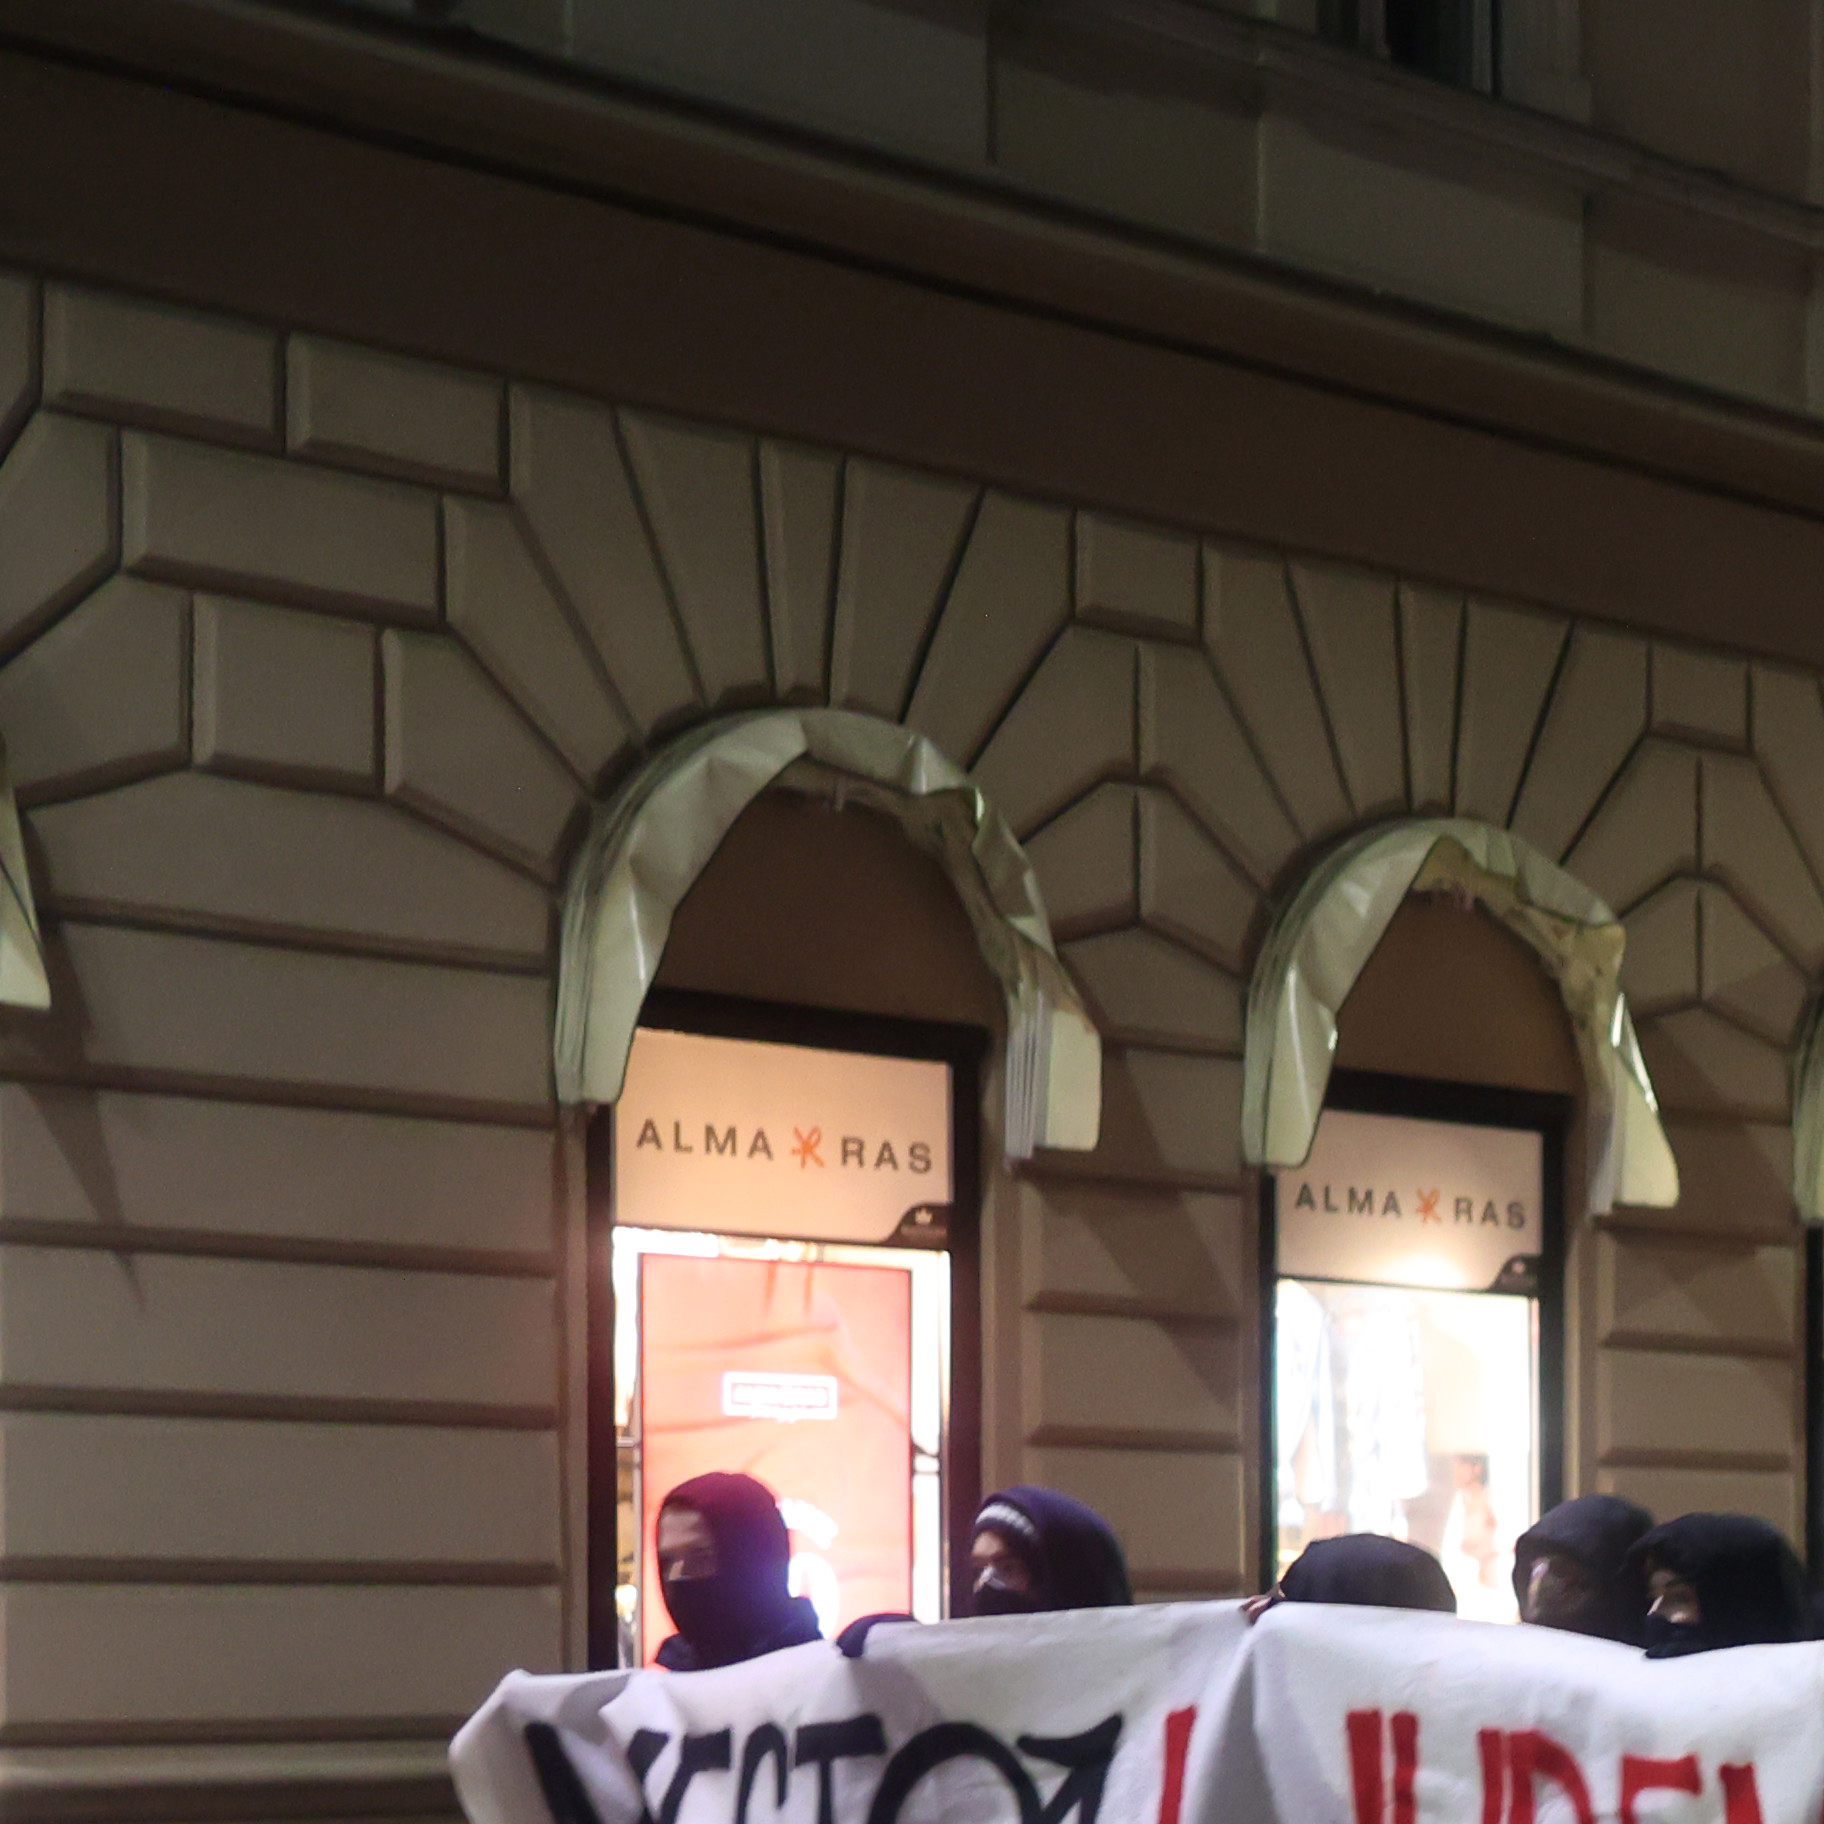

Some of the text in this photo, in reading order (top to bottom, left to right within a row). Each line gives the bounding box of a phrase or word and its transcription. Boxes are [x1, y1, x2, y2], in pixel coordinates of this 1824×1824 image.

[636, 1118, 932, 1174] ALMA RAS
[1294, 1183, 1525, 1230] ALMA RAS
